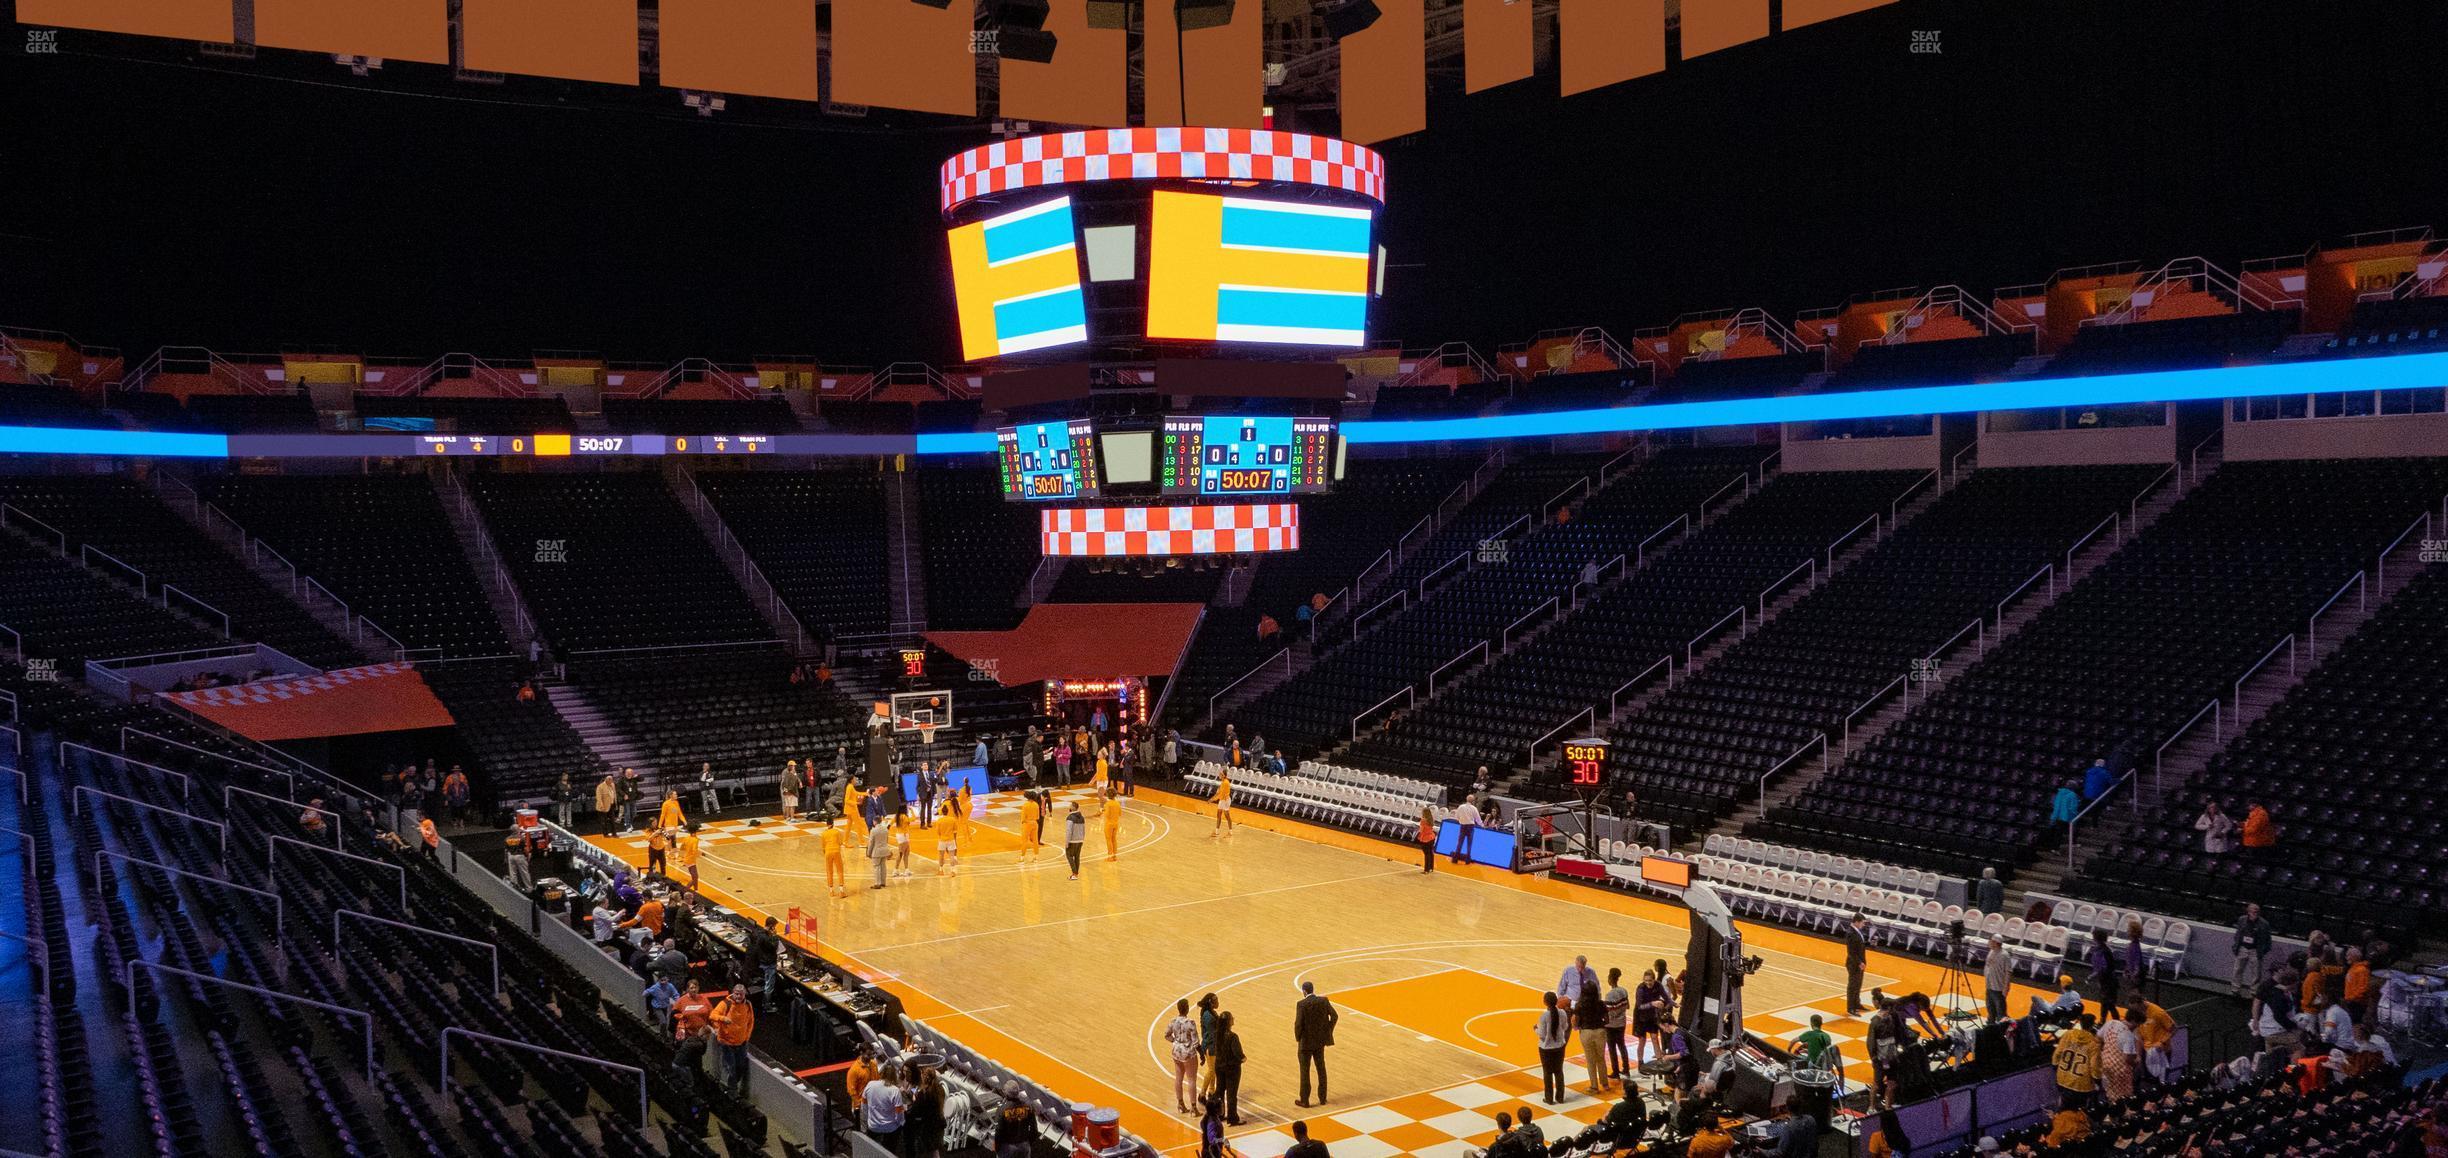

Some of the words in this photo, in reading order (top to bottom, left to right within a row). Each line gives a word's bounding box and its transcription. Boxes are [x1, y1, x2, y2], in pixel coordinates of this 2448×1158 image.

[1165, 435, 1176, 443] 00
[1181, 435, 1185, 443] 1
[1193, 435, 1199, 443] 9
[1246, 429, 1251, 440] 1
[513, 439, 523, 452] 0
[579, 438, 623, 451] 50:07
[676, 438, 686, 452] 0
[1041, 435, 1046, 447] 1
[436, 443, 445, 453] 0
[473, 443, 481, 452] 4
[717, 443, 725, 451] 4
[748, 443, 756, 451] 0
[1168, 446, 1172, 454] 1
[1180, 446, 1186, 454] 3
[1191, 446, 1201, 454] 17
[1294, 446, 1302, 454] 11
[1212, 449, 1219, 461] 0
[1231, 455, 1237, 463] 4
[1257, 455, 1263, 463] 4
[1275, 448, 1282, 461] 0
[1026, 456, 1031, 468] 0
[1061, 453, 1067, 466] 0
[1166, 457, 1175, 465] 13
[1193, 457, 1198, 465] 8
[1308, 456, 1313, 464] 2
[1318, 456, 1323, 464] 7
[1037, 461, 1041, 469] 4
[1052, 460, 1056, 469] 4
[1190, 467, 1200, 475] 10
[1191, 478, 1197, 486] 0
[1222, 471, 1271, 488] 50:07
[1277, 480, 1283, 488] 0
[1034, 475, 1063, 494] 50:07
[1067, 484, 1072, 493] 0
[1207, 480, 1214, 489] 0
[1028, 486, 1032, 495] 0
[903, 652, 924, 662] 50:07
[907, 661, 921, 675] 30
[1566, 746, 1604, 761] 50:07
[1573, 760, 1599, 783] 30
[2060, 1049, 2087, 1076] 92
